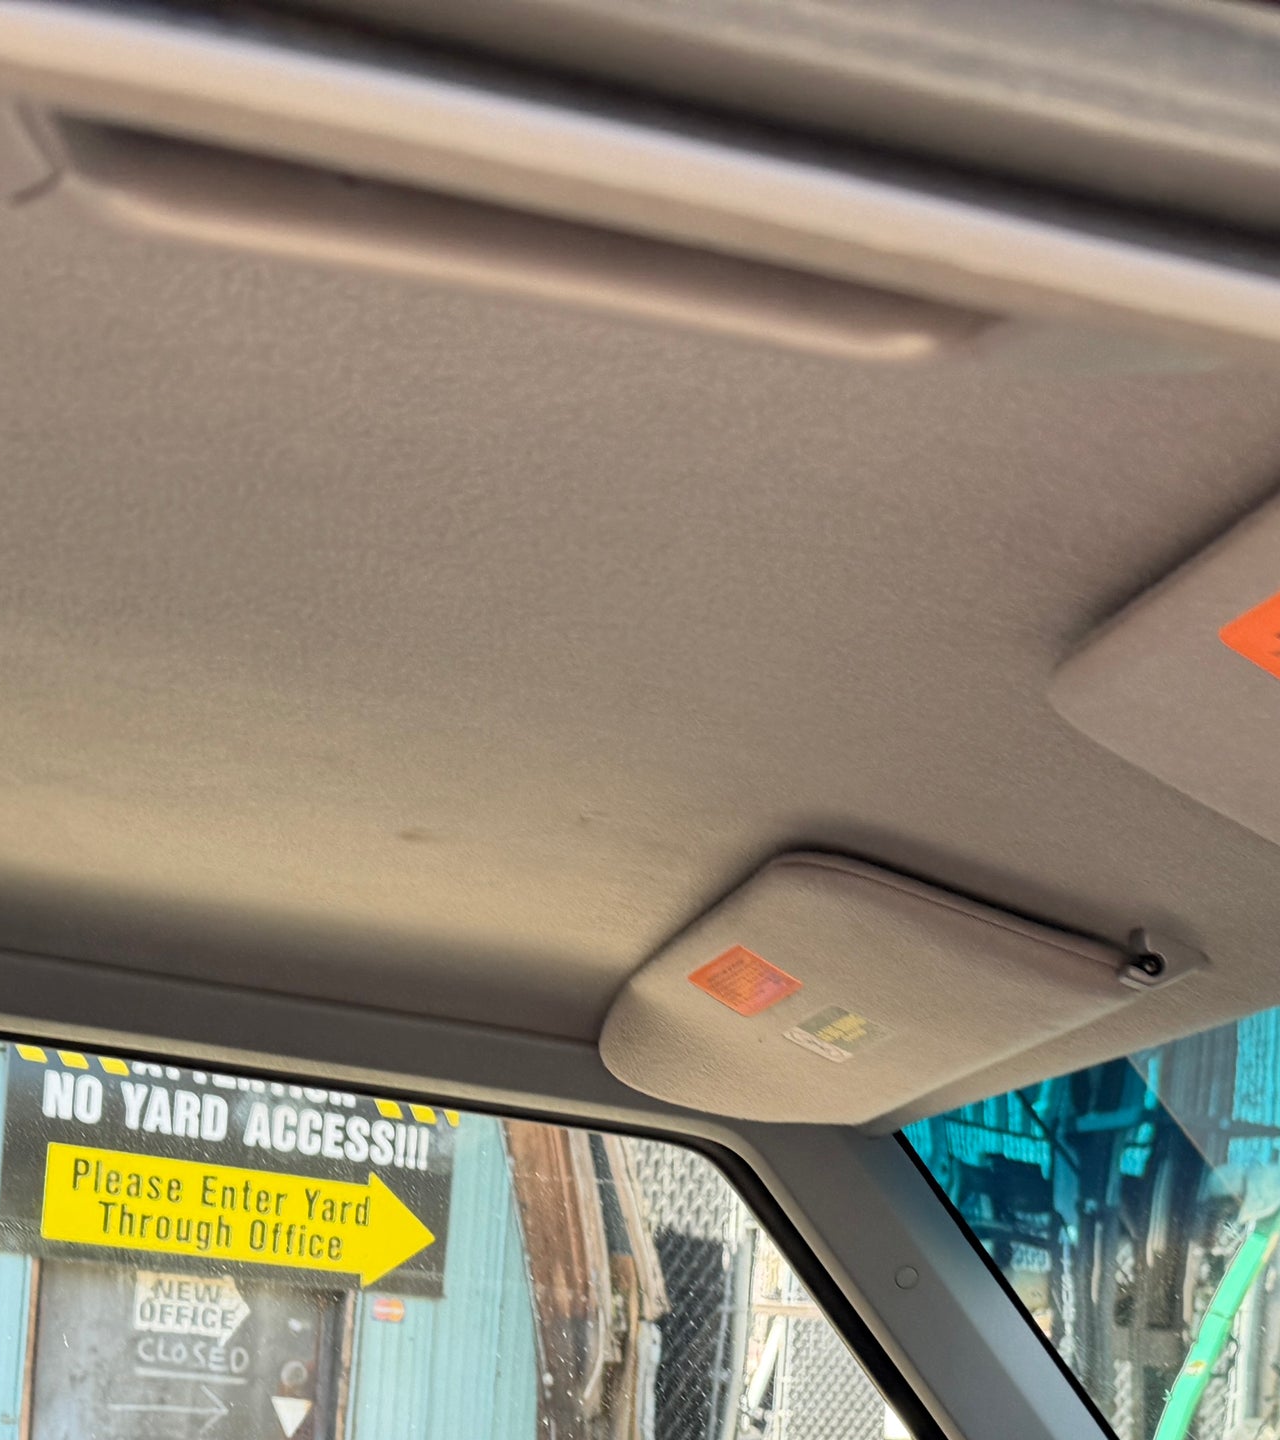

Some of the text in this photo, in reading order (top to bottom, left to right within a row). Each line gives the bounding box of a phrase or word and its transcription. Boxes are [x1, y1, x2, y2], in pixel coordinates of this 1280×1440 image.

[42, 1069, 103, 1125] NO
[120, 1081, 228, 1142] YARD
[242, 1103, 430, 1171] ACCESS!!!
[72, 1158, 370, 1228] Please Enter Yard
[98, 1200, 344, 1261] Through Office
[139, 1300, 238, 1330] OFFICE
[154, 1279, 220, 1302] NEW
[137, 1338, 250, 1375] CLOSED
